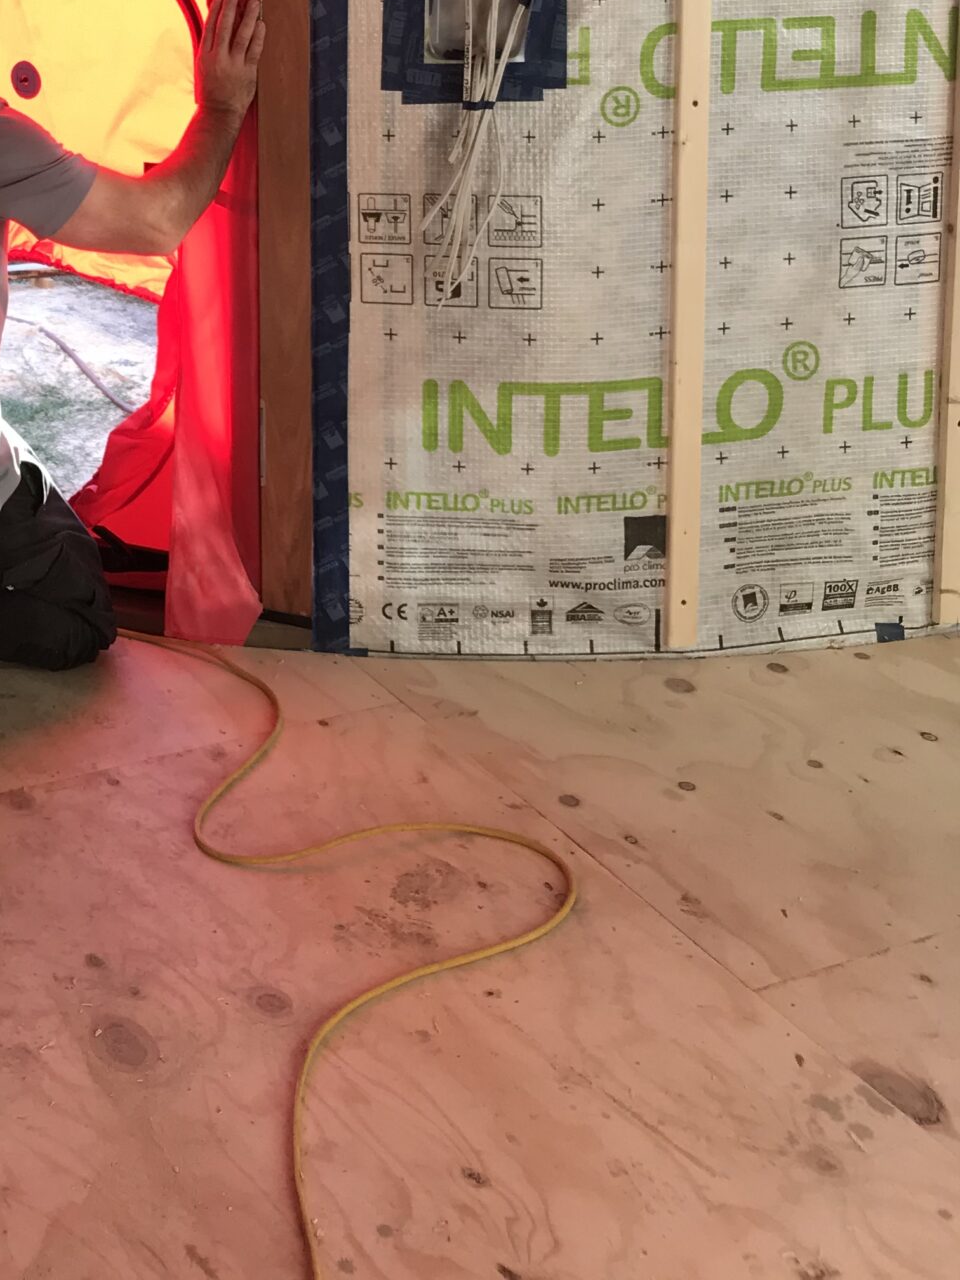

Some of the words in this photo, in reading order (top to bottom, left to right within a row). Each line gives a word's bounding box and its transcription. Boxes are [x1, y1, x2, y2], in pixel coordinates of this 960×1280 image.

[823, 370, 934, 434] PLU
[812, 477, 853, 494] PLUS
[490, 499, 534, 515] PLUS
[826, 582, 856, 594] 100X
[382, 603, 408, 621] CE
